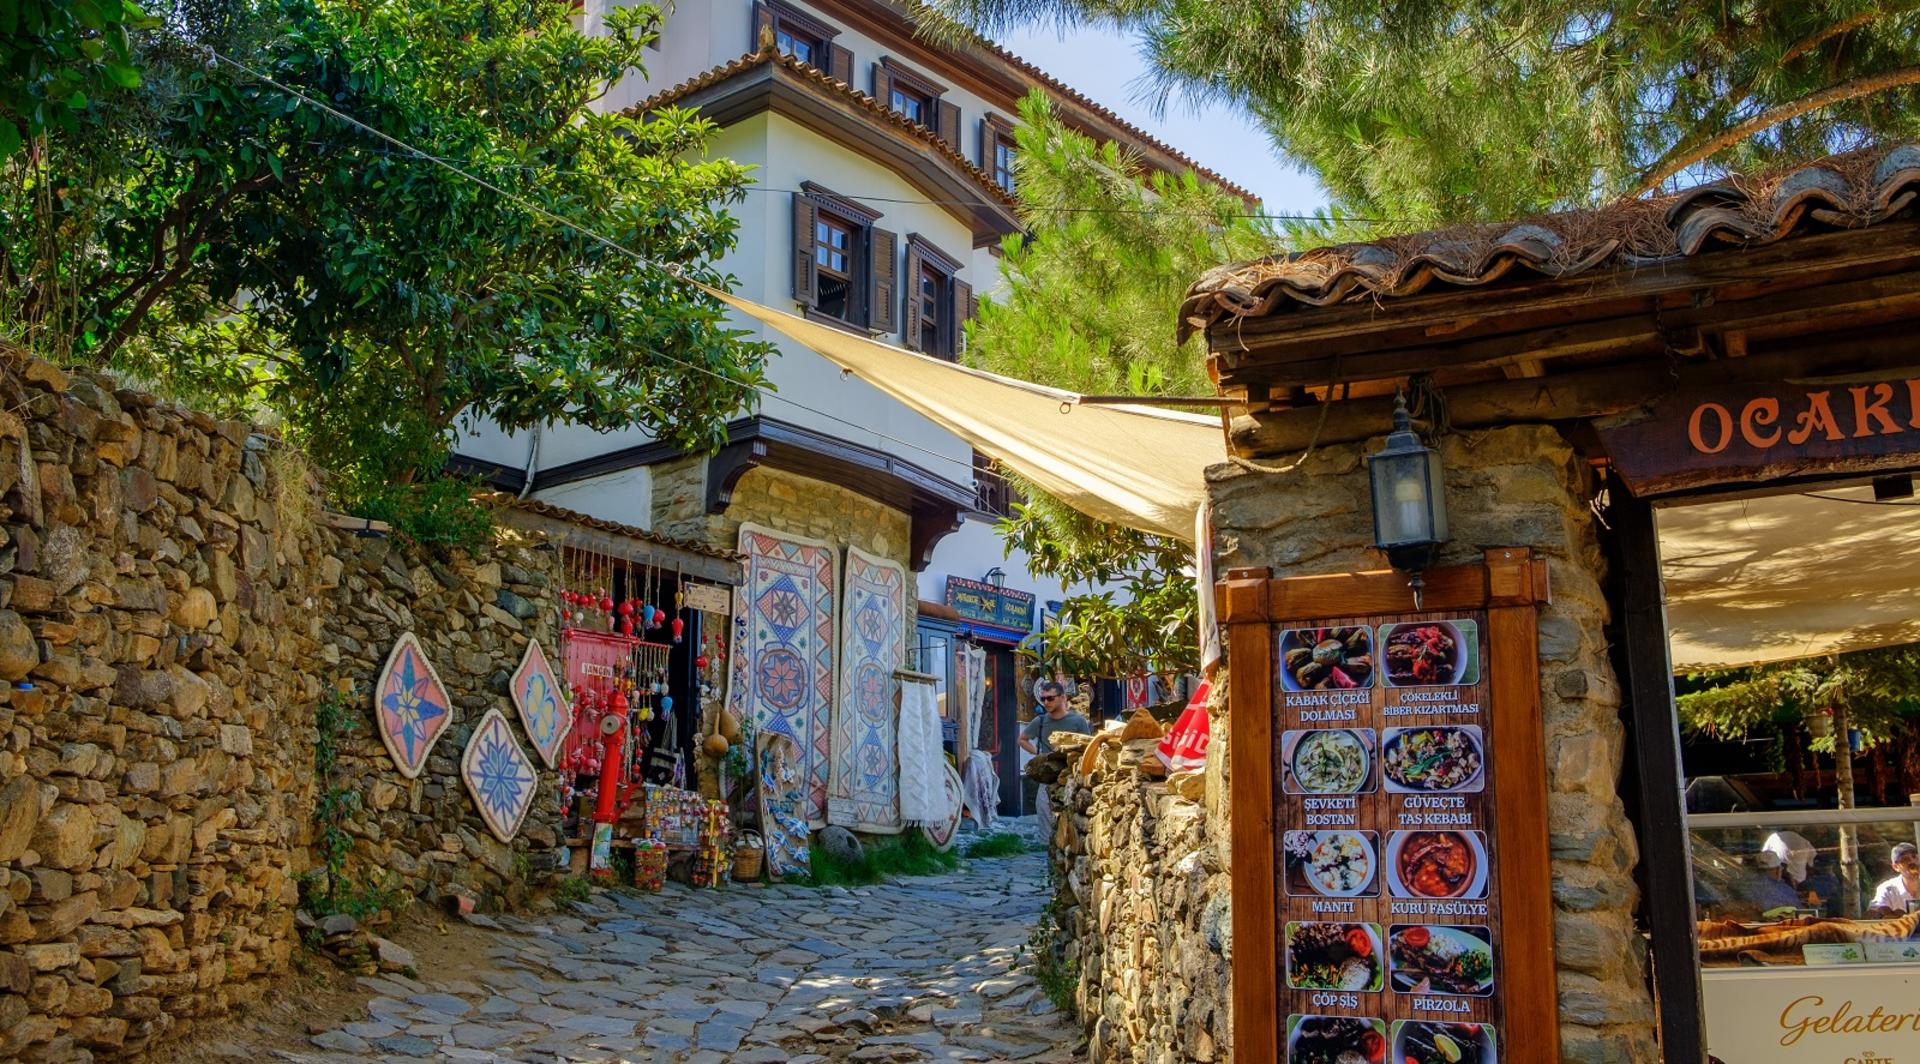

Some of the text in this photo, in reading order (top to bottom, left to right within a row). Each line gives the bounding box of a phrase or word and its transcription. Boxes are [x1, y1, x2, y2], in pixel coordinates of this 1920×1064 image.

[1285, 690, 1371, 707] KABAK ÇİÇEĞİ
[1400, 689, 1458, 703] ÇÖKELEKLİ
[1300, 709, 1356, 722] DOLMASI
[1383, 703, 1479, 716] BİBER KIZARTMASI
[1304, 796, 1356, 811] ŞEVKETİ
[1404, 795, 1465, 810] GÜVEÇTE
[1306, 814, 1355, 825] BOSTAN
[1398, 812, 1472, 825] TAS KEBABI
[1312, 901, 1355, 913] MANTI
[1391, 901, 1488, 915] KURU FASÜLYE
[1312, 993, 1358, 1009] ÇÖP ŞİŞ
[1413, 996, 1471, 1012] PİRZOLA
